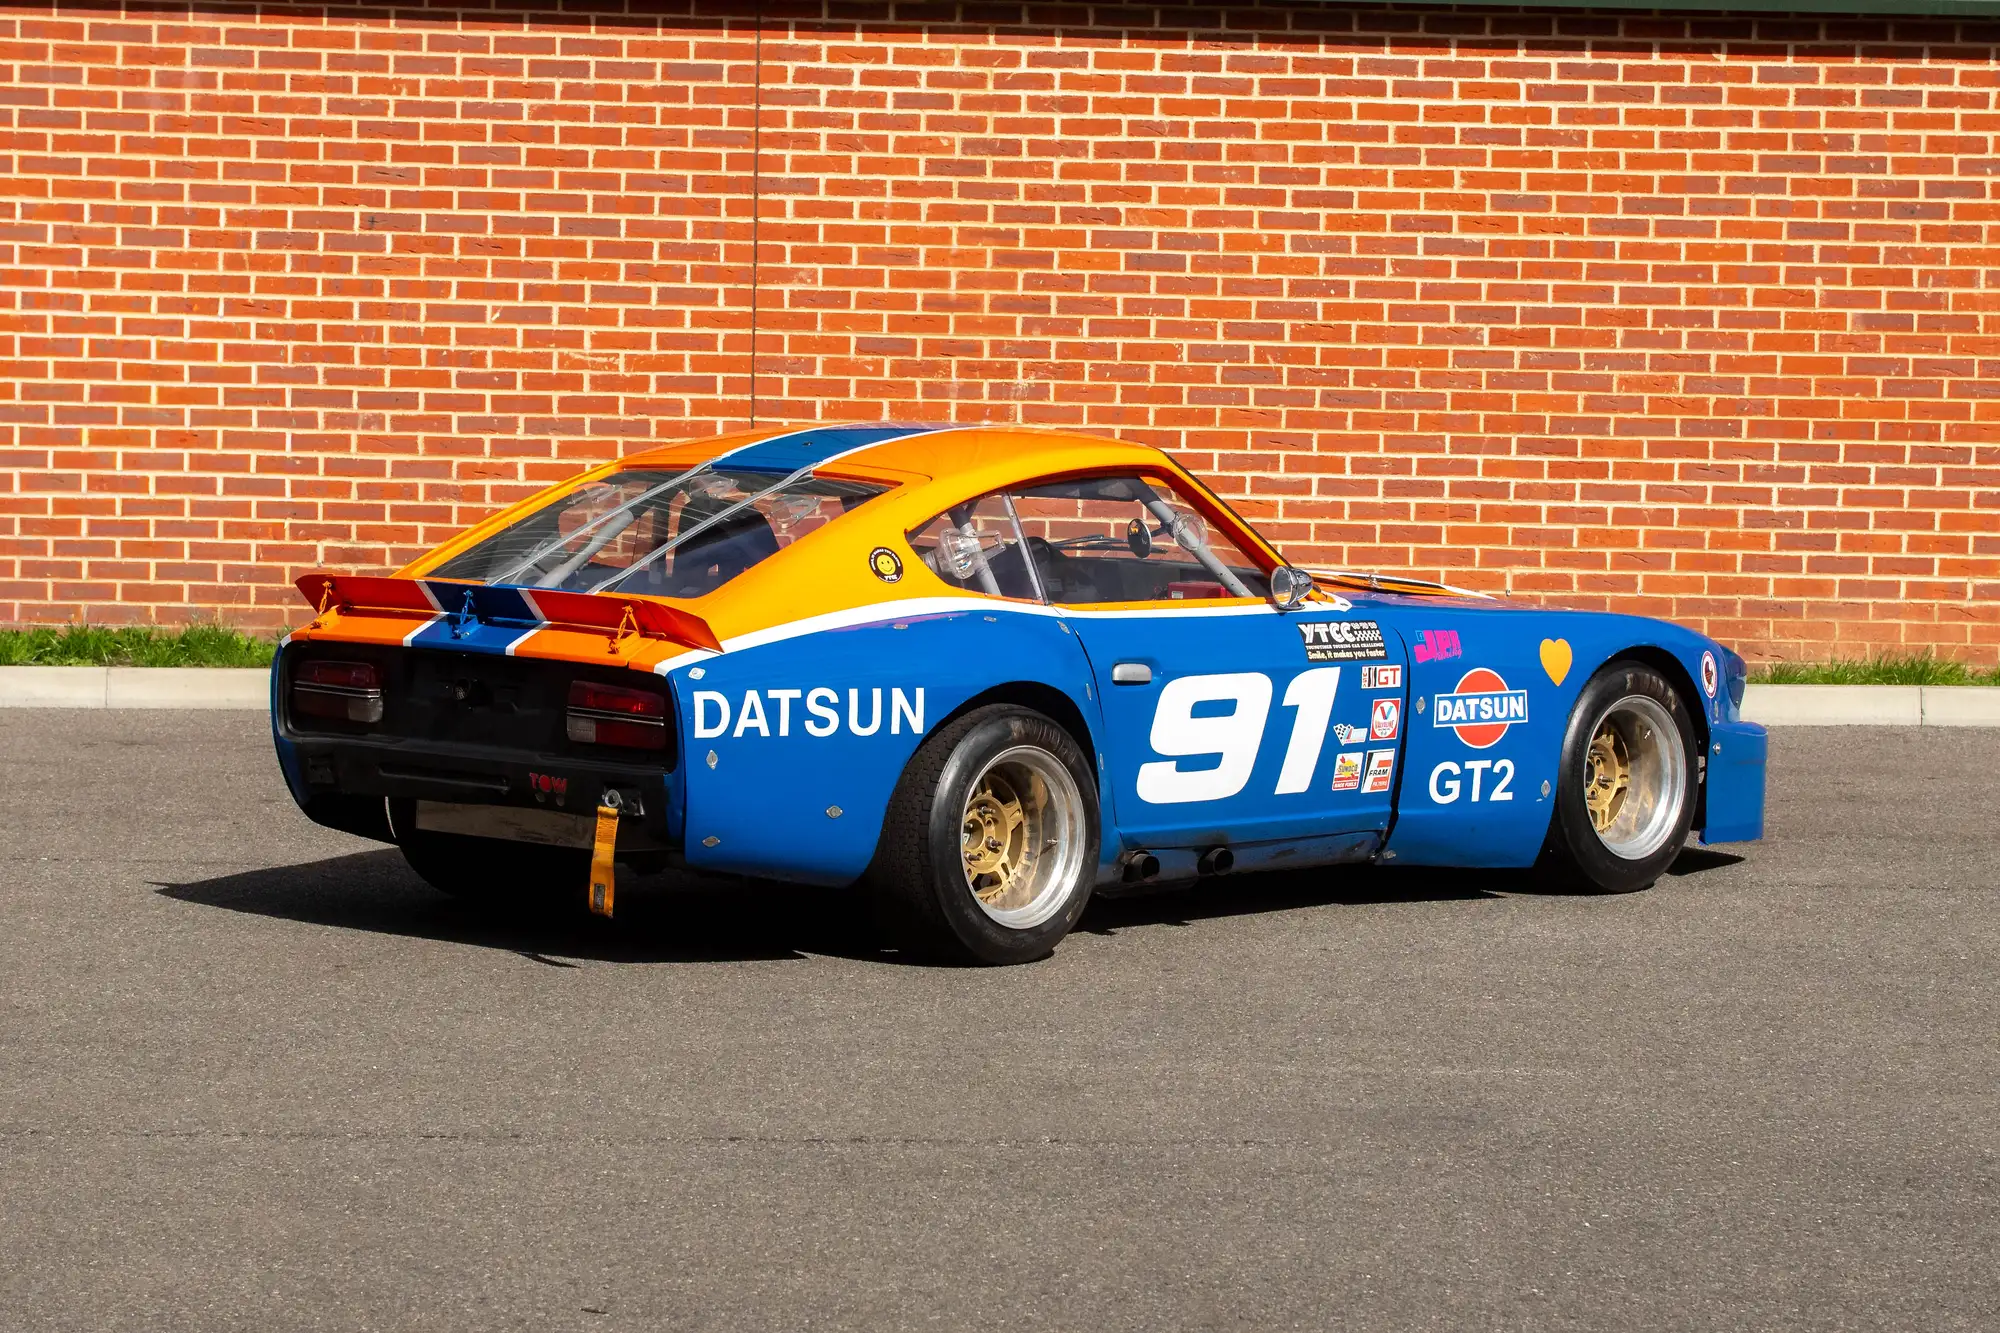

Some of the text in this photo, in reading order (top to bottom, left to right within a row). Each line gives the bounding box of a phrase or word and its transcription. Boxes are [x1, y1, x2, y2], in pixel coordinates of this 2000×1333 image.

[1297, 622, 1356, 644] YTCC
[1307, 648, 1385, 660] Smile, it makes you faster
[1378, 667, 1400, 685] GT
[693, 687, 925, 738] DATSUN
[1437, 696, 1525, 722] DATSUN
[1136, 666, 1341, 804] 91
[529, 772, 568, 793] TOW
[1368, 768, 1388, 776] FRAM
[1428, 758, 1515, 805] GT2
